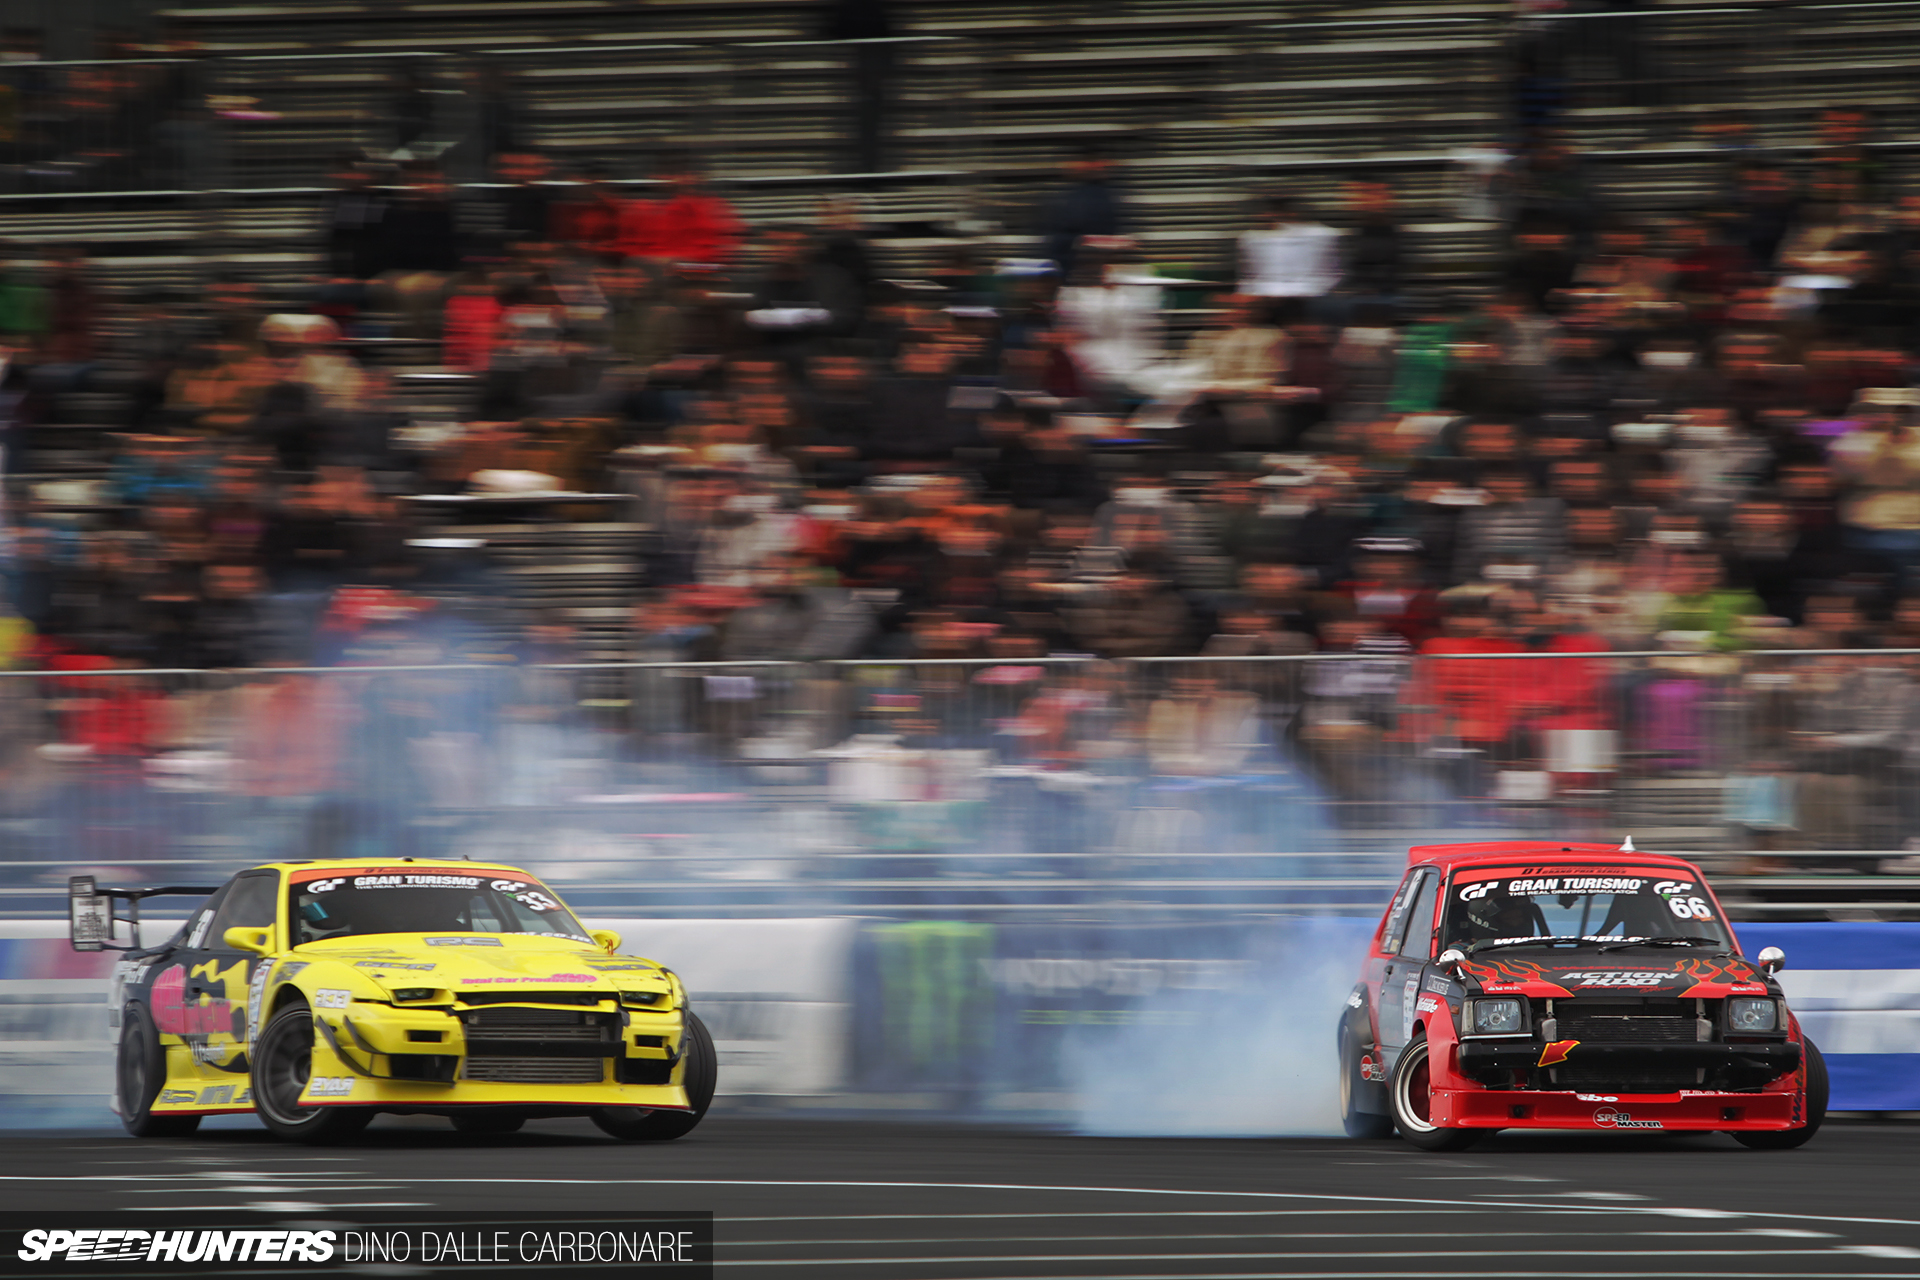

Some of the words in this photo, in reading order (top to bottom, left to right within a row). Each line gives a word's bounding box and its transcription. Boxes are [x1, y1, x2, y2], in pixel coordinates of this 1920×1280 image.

[354, 875, 403, 886] GRAN
[404, 875, 480, 886] TURISMO
[1508, 878, 1559, 891] GRAN
[1563, 877, 1642, 890] TURISMO
[1668, 896, 1712, 919] 66
[1560, 971, 1680, 980] ACTION
[1596, 1112, 1631, 1122] SPEED
[1616, 1120, 1663, 1128] MASTER
